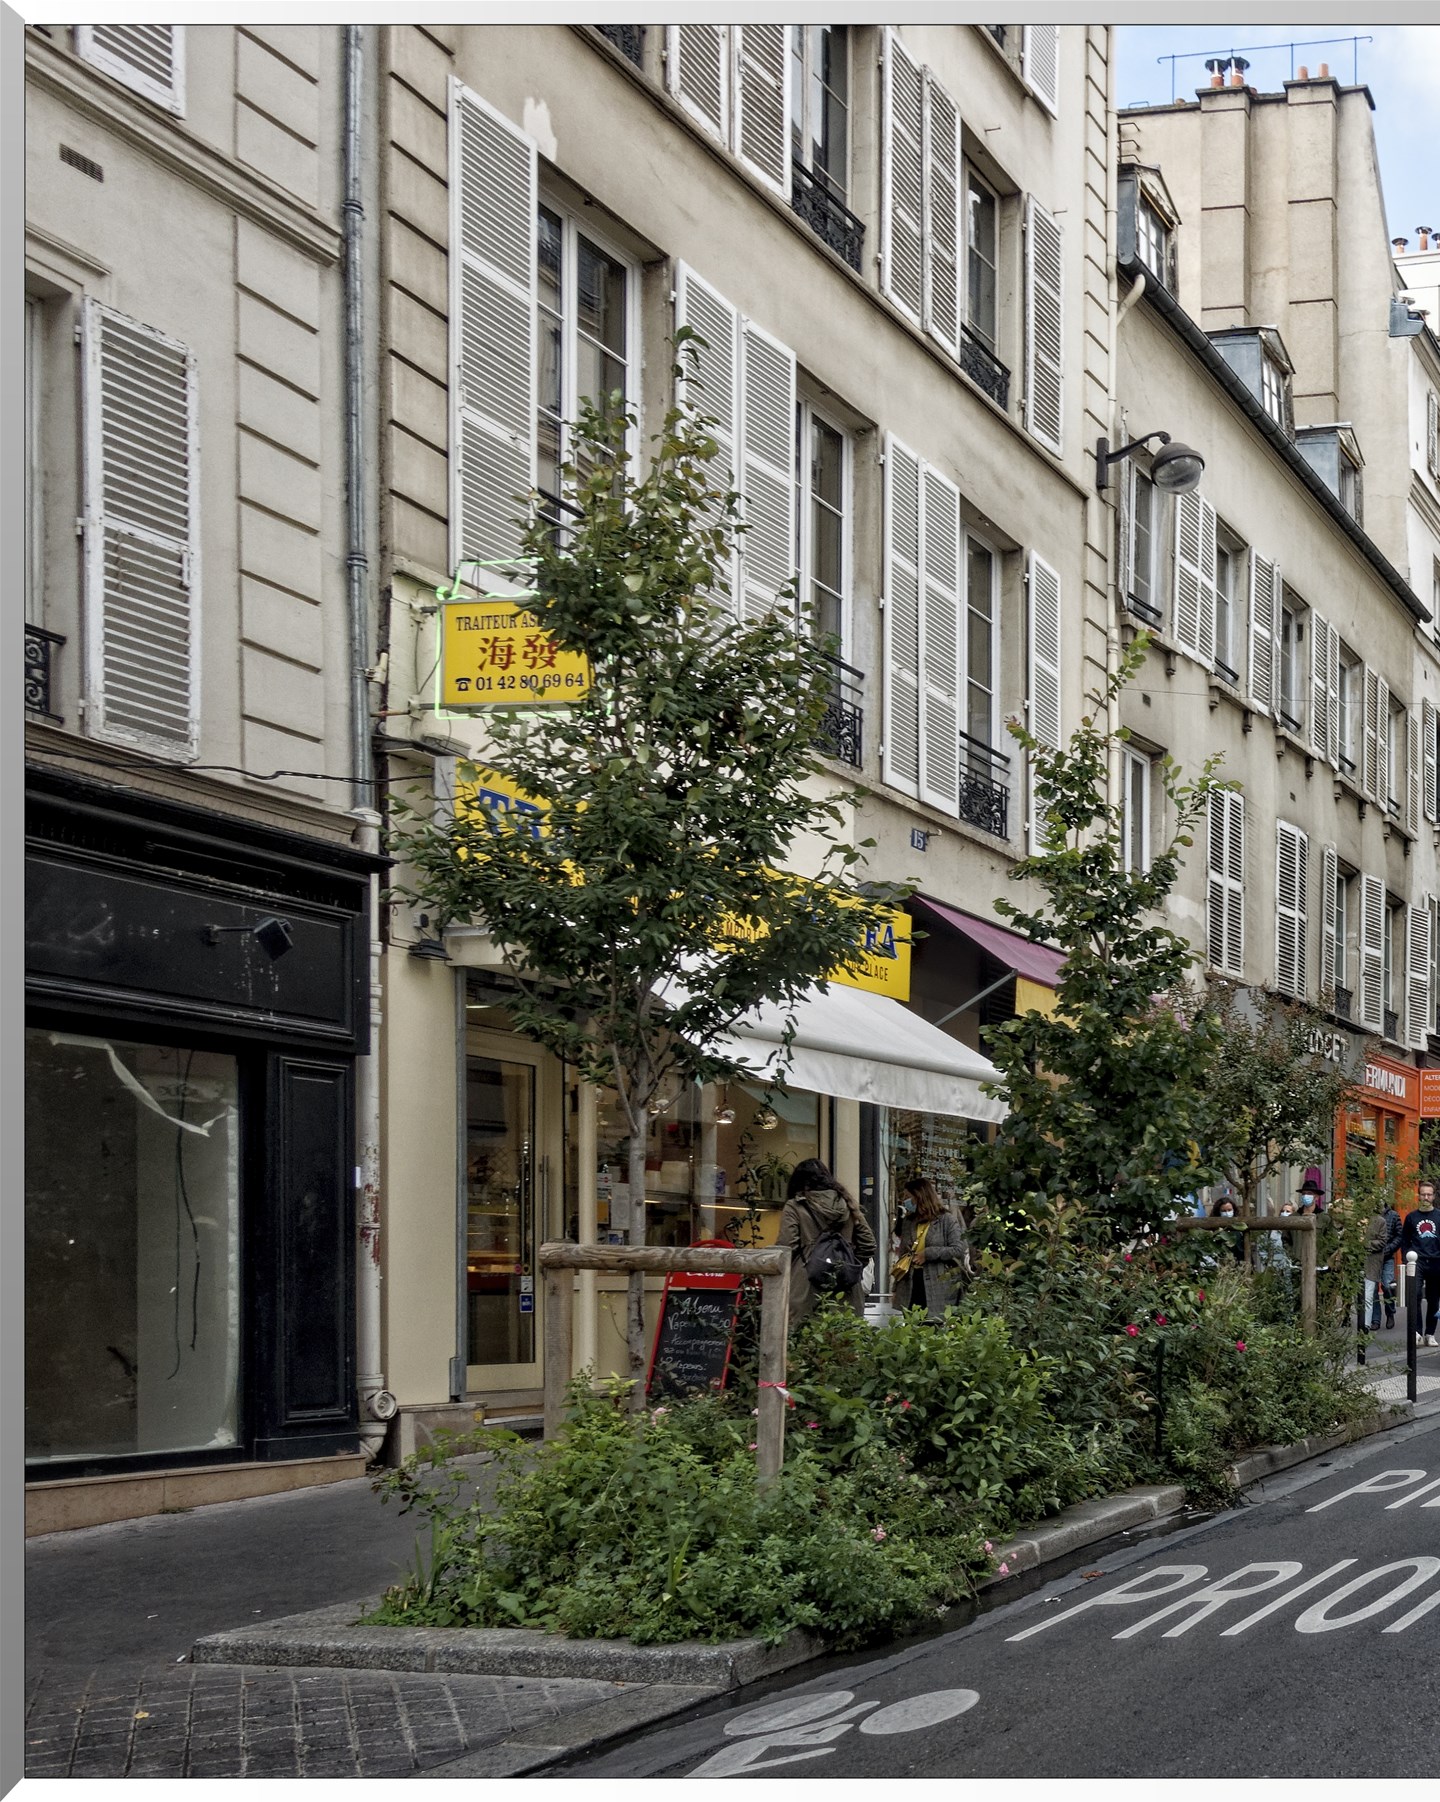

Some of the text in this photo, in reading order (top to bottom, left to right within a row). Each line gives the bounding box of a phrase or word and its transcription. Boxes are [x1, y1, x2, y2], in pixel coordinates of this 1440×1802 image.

[456, 615, 517, 631] TRAITEUR
[477, 633, 561, 672] 海發
[475, 671, 585, 691] 01 42 80 69 64
[913, 829, 925, 849] 15
